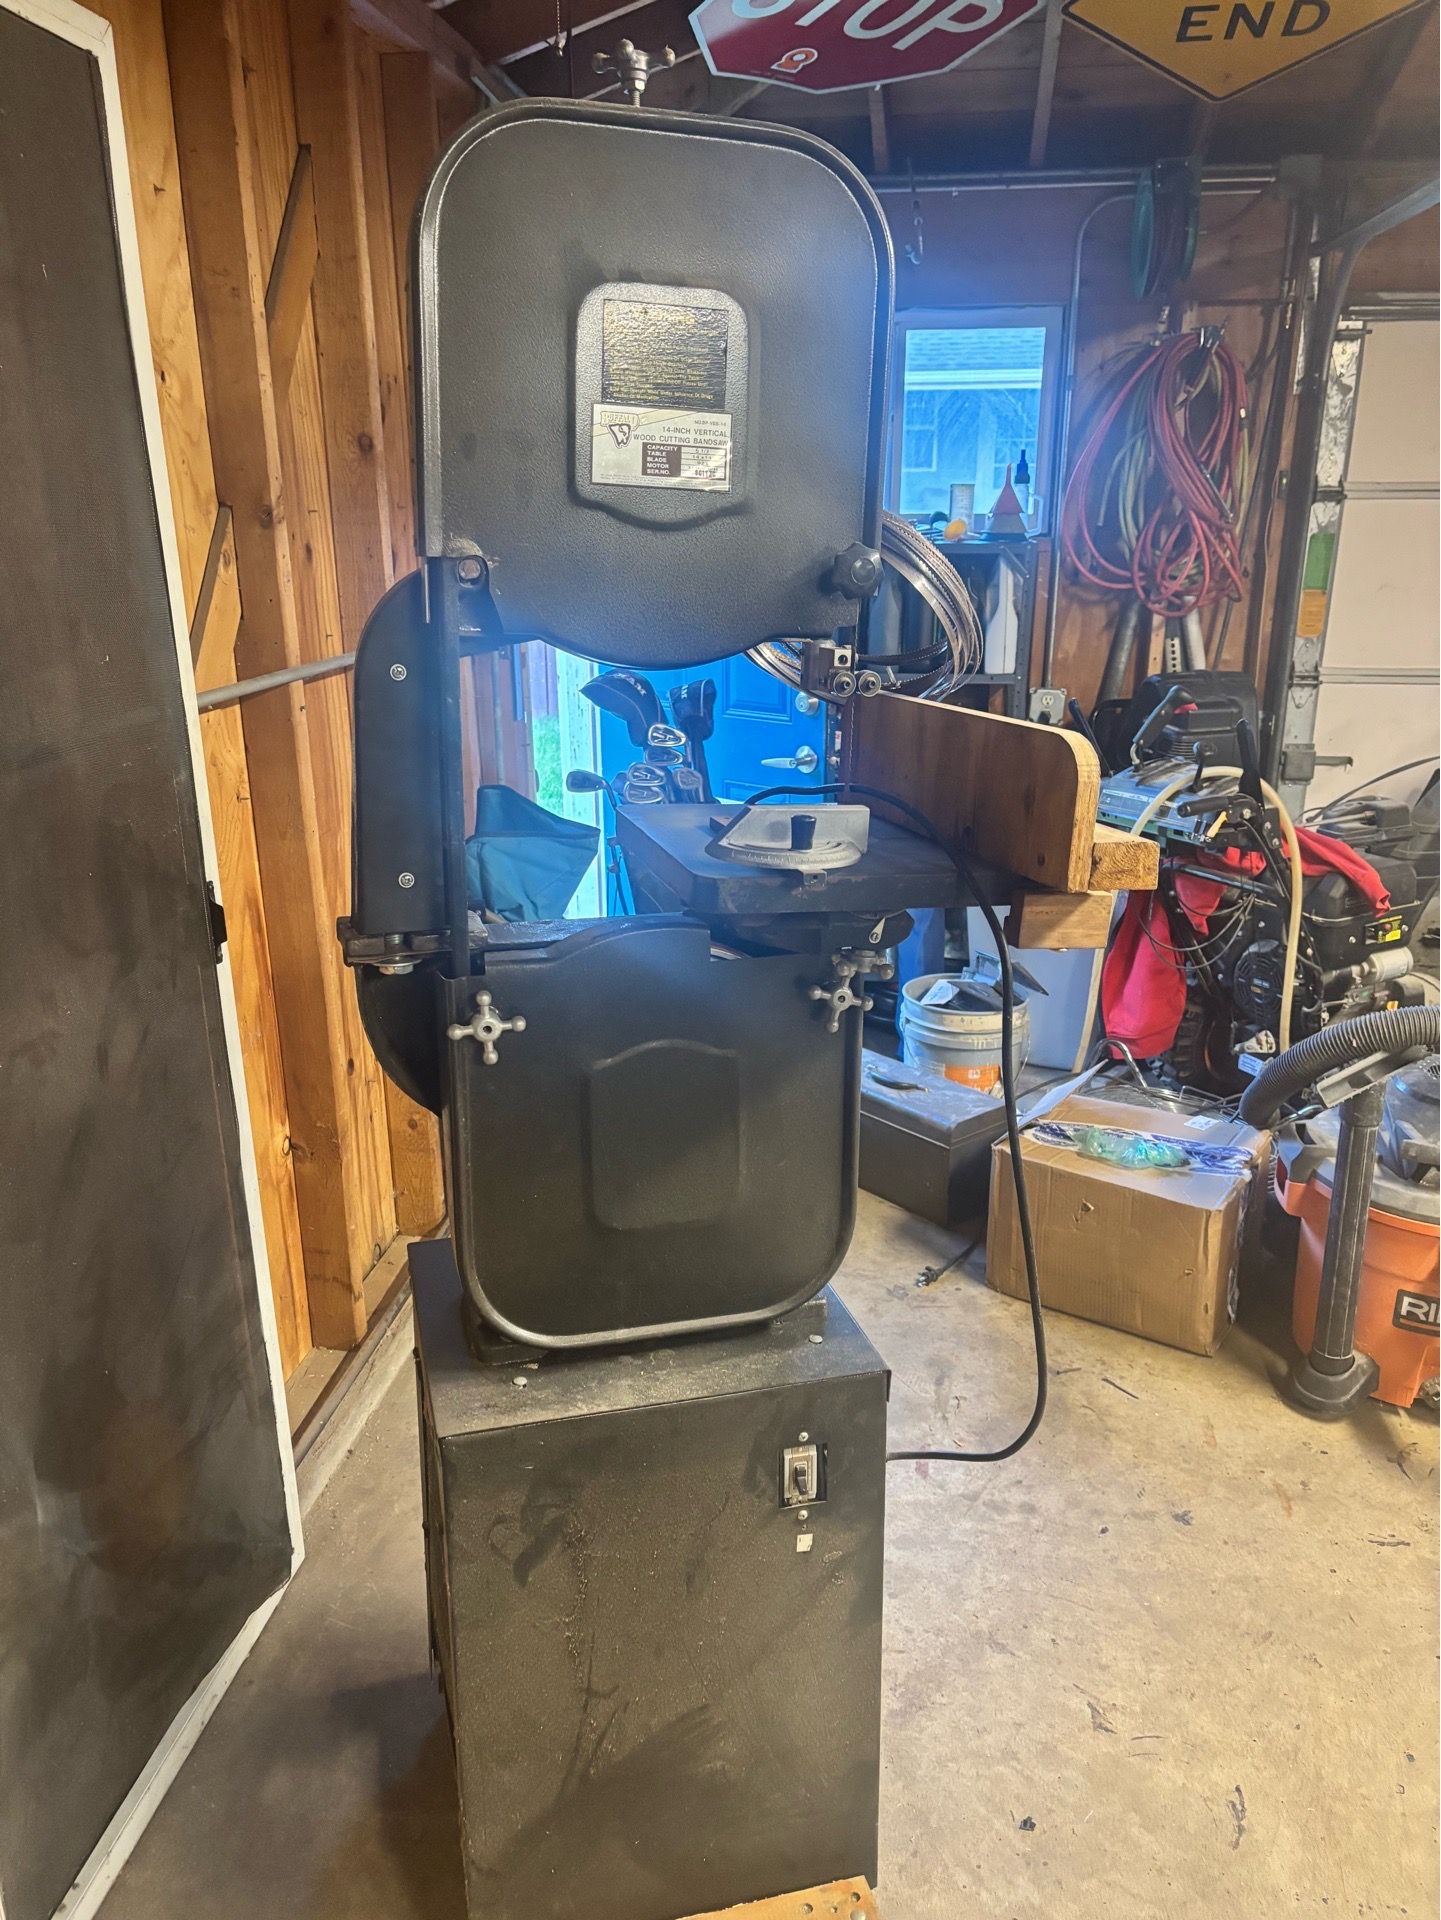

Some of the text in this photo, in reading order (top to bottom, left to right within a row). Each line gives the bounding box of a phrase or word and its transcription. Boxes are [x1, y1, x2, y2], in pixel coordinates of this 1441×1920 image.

[1175, 0, 1331, 43] END
[662, 426, 729, 438] 14-INCH VERTICAL
[633, 433, 729, 446] WOOD CUTTING BANDSAW
